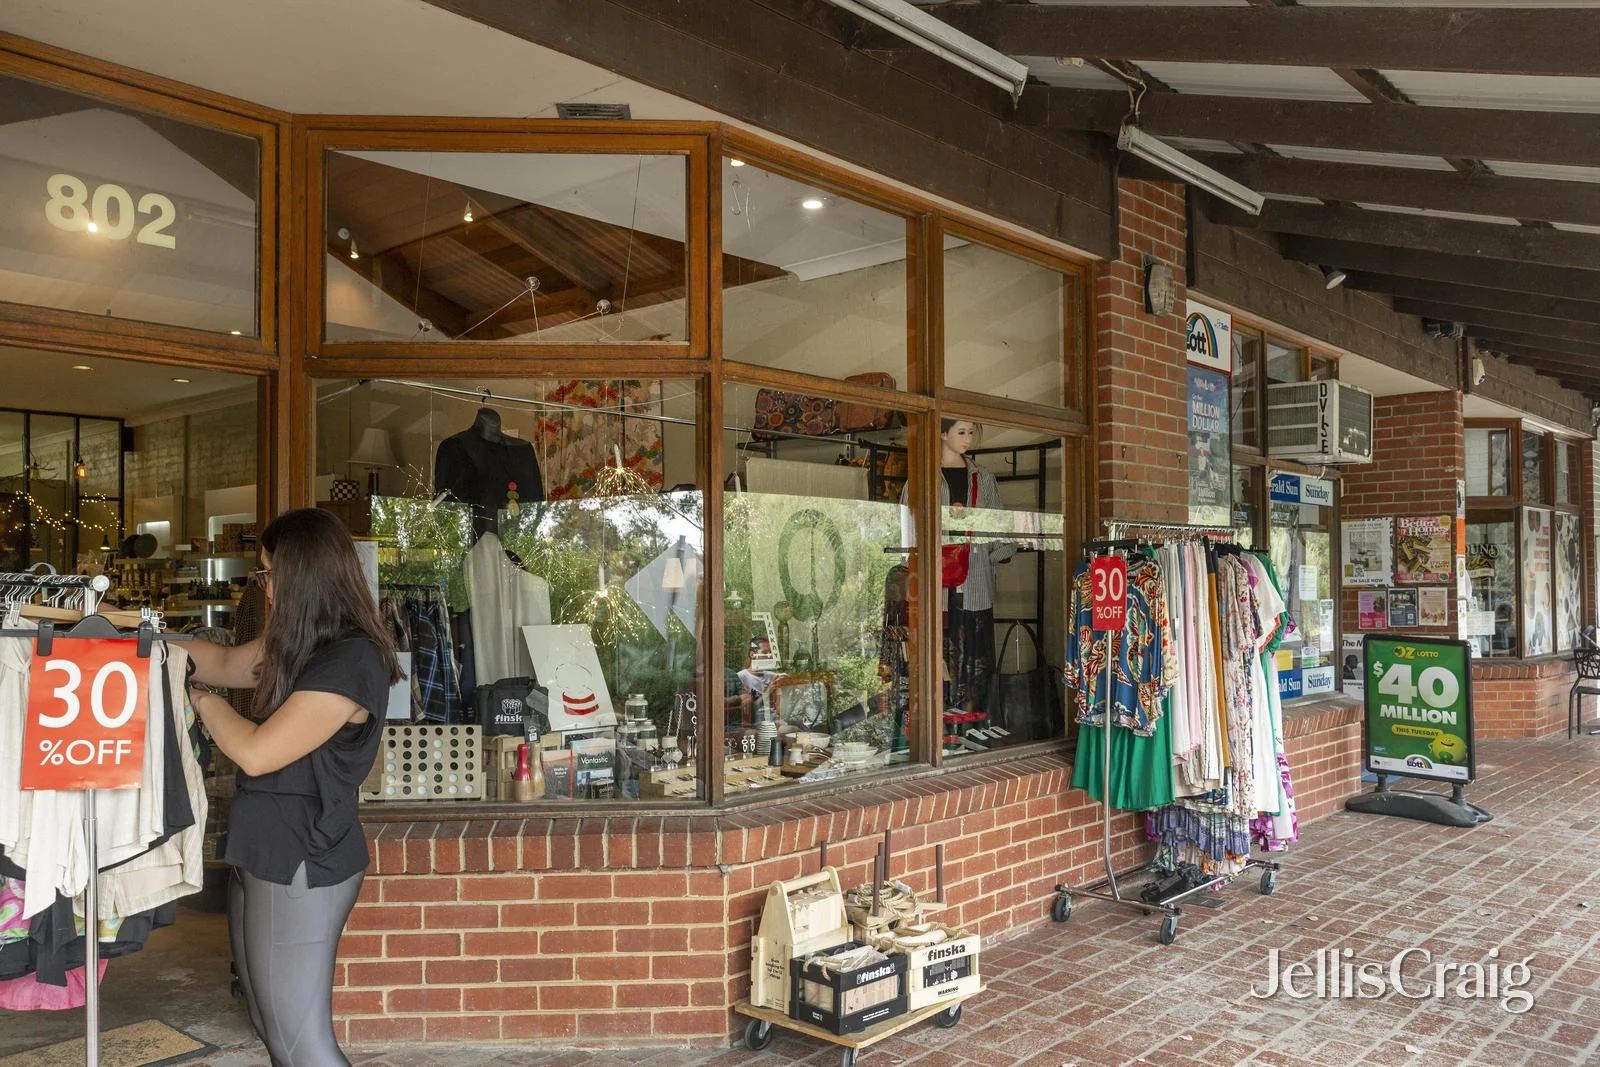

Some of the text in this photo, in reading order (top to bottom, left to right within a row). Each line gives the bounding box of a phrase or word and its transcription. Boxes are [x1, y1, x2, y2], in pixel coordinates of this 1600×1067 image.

[45, 173, 176, 249] 802
[1192, 399, 1220, 420] MILLION
[1192, 415, 1219, 433] DOLLAR
[1286, 481, 1299, 496] Sun
[1305, 484, 1330, 503] Sunday
[1401, 519, 1436, 528] Better
[1094, 567, 1124, 602] 30
[1096, 606, 1123, 620] %OFF
[1393, 646, 1416, 659] OZ
[1288, 677, 1301, 691] Sun
[1308, 673, 1331, 689] Sunday
[38, 659, 138, 728] 30
[1380, 704, 1457, 725] MILLION
[1411, 728, 1439, 737] TUESDAY
[39, 739, 132, 766] %OFF
[580, 755, 609, 765] Vantastic
[927, 944, 966, 961] finska
[861, 966, 891, 983] finska
[937, 986, 959, 995] WARNING
